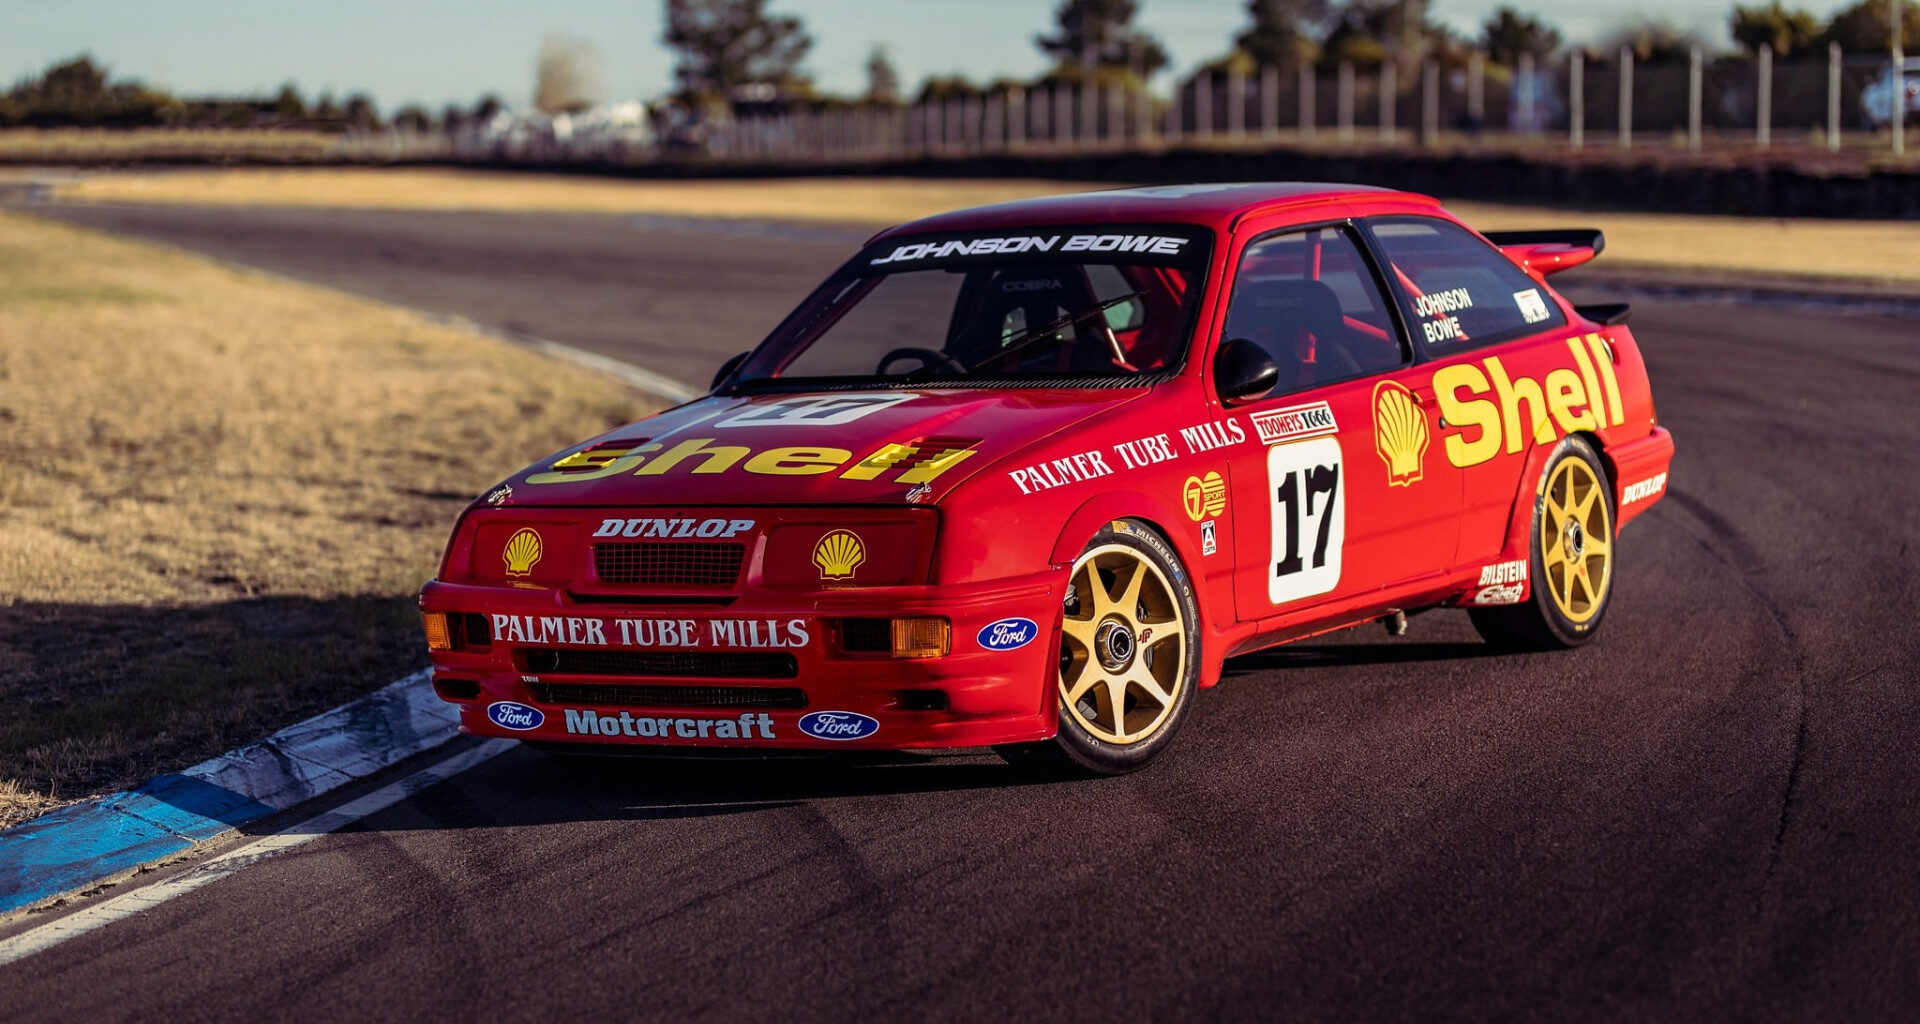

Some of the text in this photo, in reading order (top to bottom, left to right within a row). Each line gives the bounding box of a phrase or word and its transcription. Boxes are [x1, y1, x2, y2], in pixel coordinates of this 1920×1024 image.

[870, 235, 1189, 264] JOHNSON BOWE
[1416, 287, 1473, 317] JOHNSON
[1422, 316, 1463, 343] BOWE
[735, 397, 894, 422] 17
[1432, 333, 1625, 468] Shell
[1256, 413, 1304, 436] TOOHEYS
[525, 438, 979, 485] Shell
[1008, 417, 1246, 495] PALMER TUBE MILLS
[1203, 490, 1226, 501] SPORT
[1621, 473, 1667, 506] DUNLOP
[592, 518, 755, 538] DUNLOP
[1277, 463, 1338, 577] 17
[1135, 528, 1180, 573] MICHELIN
[1478, 559, 1527, 586] BILSTEIN
[491, 613, 810, 648] PALMER TUBE MILLS
[989, 622, 1027, 646] Ford
[497, 704, 532, 726] Ford
[564, 708, 776, 739] Motorcraft
[813, 713, 862, 736] Ford
